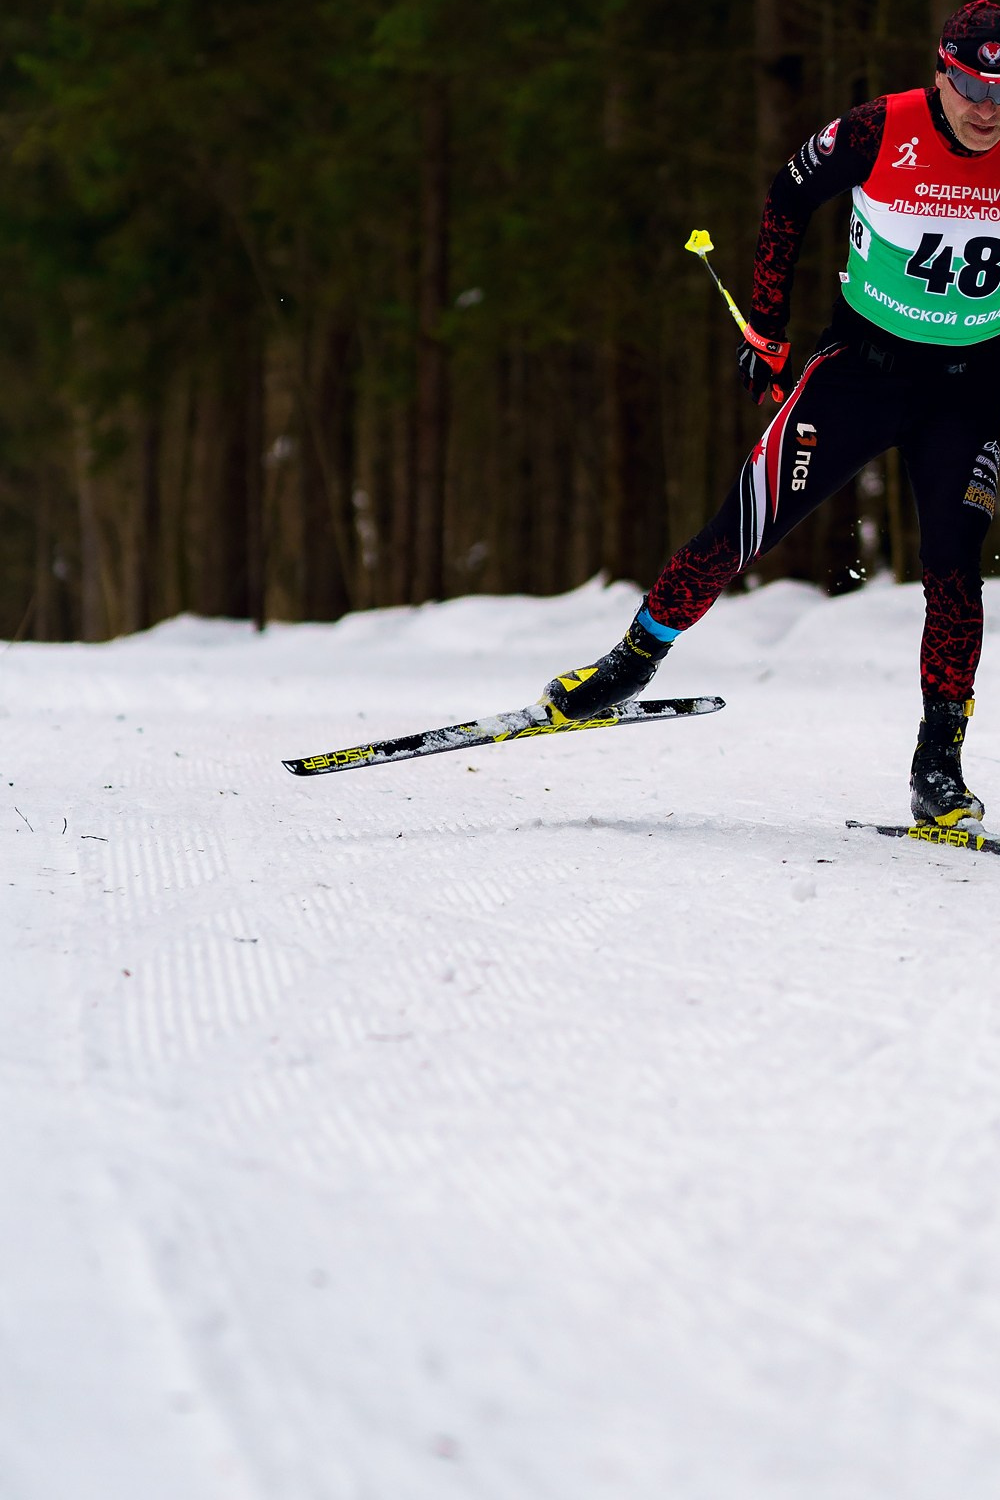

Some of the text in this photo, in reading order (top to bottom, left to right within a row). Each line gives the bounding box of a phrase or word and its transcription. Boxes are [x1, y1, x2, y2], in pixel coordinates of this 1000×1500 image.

[787, 160, 804, 185] ПСБ
[889, 198, 974, 220] ЛЫЖНЫХ
[863, 281, 958, 325] КАЛУЖСКОЙ
[791, 450, 812, 491] ПСБ
[908, 826, 969, 848] FISCHER
